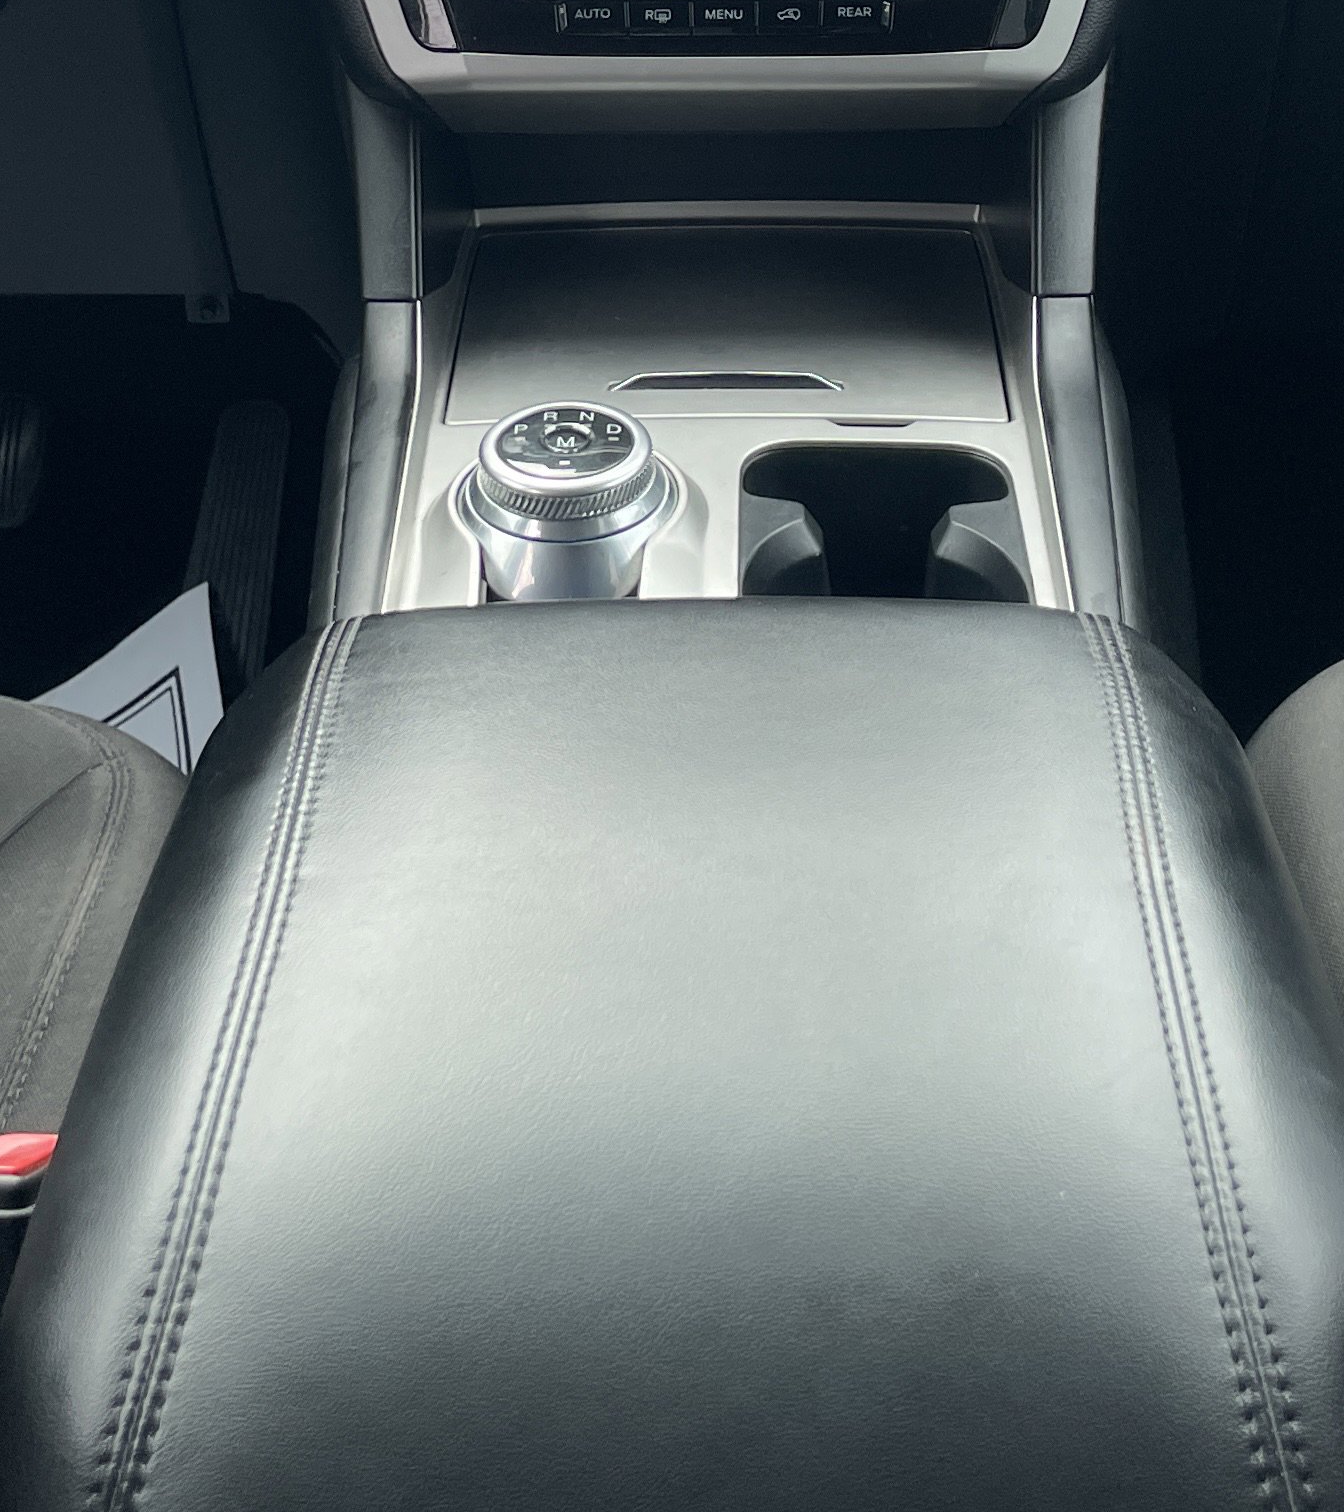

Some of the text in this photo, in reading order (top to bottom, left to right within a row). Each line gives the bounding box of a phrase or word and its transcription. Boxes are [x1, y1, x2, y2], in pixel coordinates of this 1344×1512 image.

[574, 7, 611, 20] AUTO
[704, 8, 743, 21] MENU
[837, 6, 872, 19] REAR
[514, 412, 622, 435] P R N D
[557, 437, 576, 448] M
